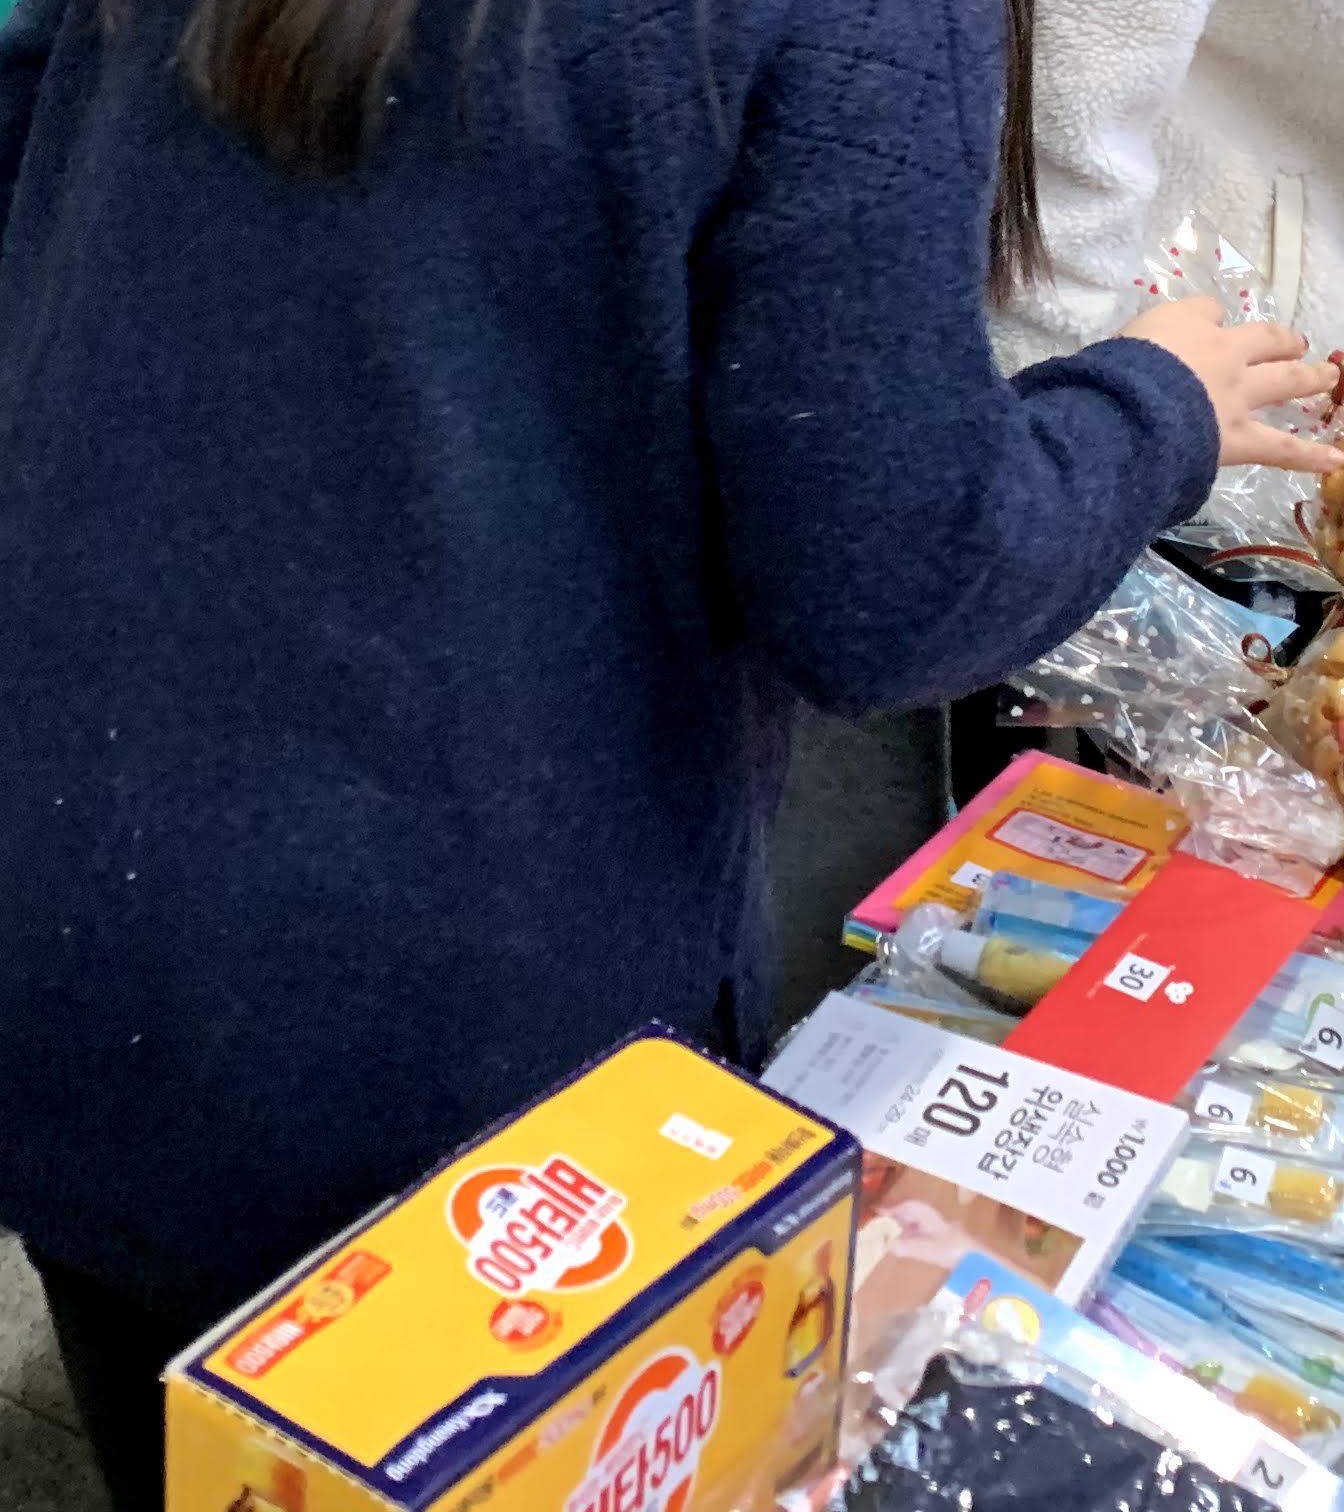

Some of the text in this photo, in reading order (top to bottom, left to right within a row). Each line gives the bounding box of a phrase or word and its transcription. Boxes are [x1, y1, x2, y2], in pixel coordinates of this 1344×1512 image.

[1117, 962, 1156, 992] 30
[1317, 1026, 1343, 1050] 6
[922, 1063, 1010, 1138] 120
[1206, 1104, 1234, 1125] 6
[977, 1085, 1064, 1181] 위생장갑
[1032, 1100, 1103, 1174] 실속형
[1229, 1166, 1257, 1187] 6
[475, 1156, 608, 1290] 비타500
[1253, 1461, 1285, 1493] 2
